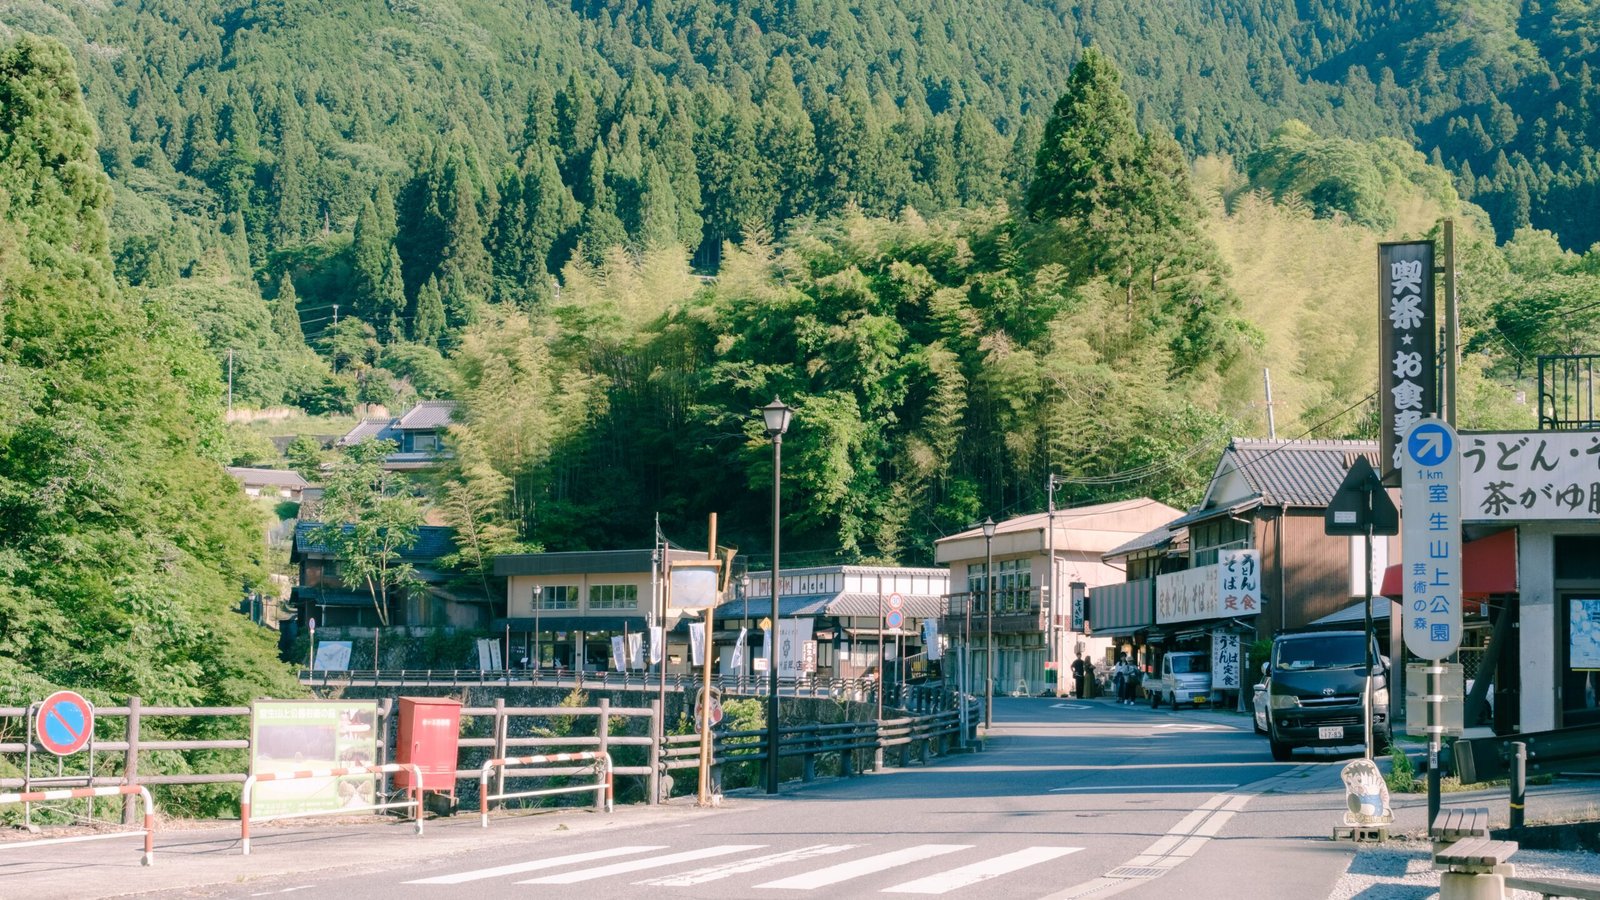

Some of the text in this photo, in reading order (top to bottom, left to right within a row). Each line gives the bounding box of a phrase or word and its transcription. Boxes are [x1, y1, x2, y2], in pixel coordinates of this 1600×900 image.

[1389, 259, 1424, 470] 喫茶★お食事
[1417, 470, 1443, 480] 1 km
[1413, 563, 1427, 630] 芸術の森
[1428, 484, 1450, 642] 室生山上公園
[1224, 594, 1257, 611] 定食
